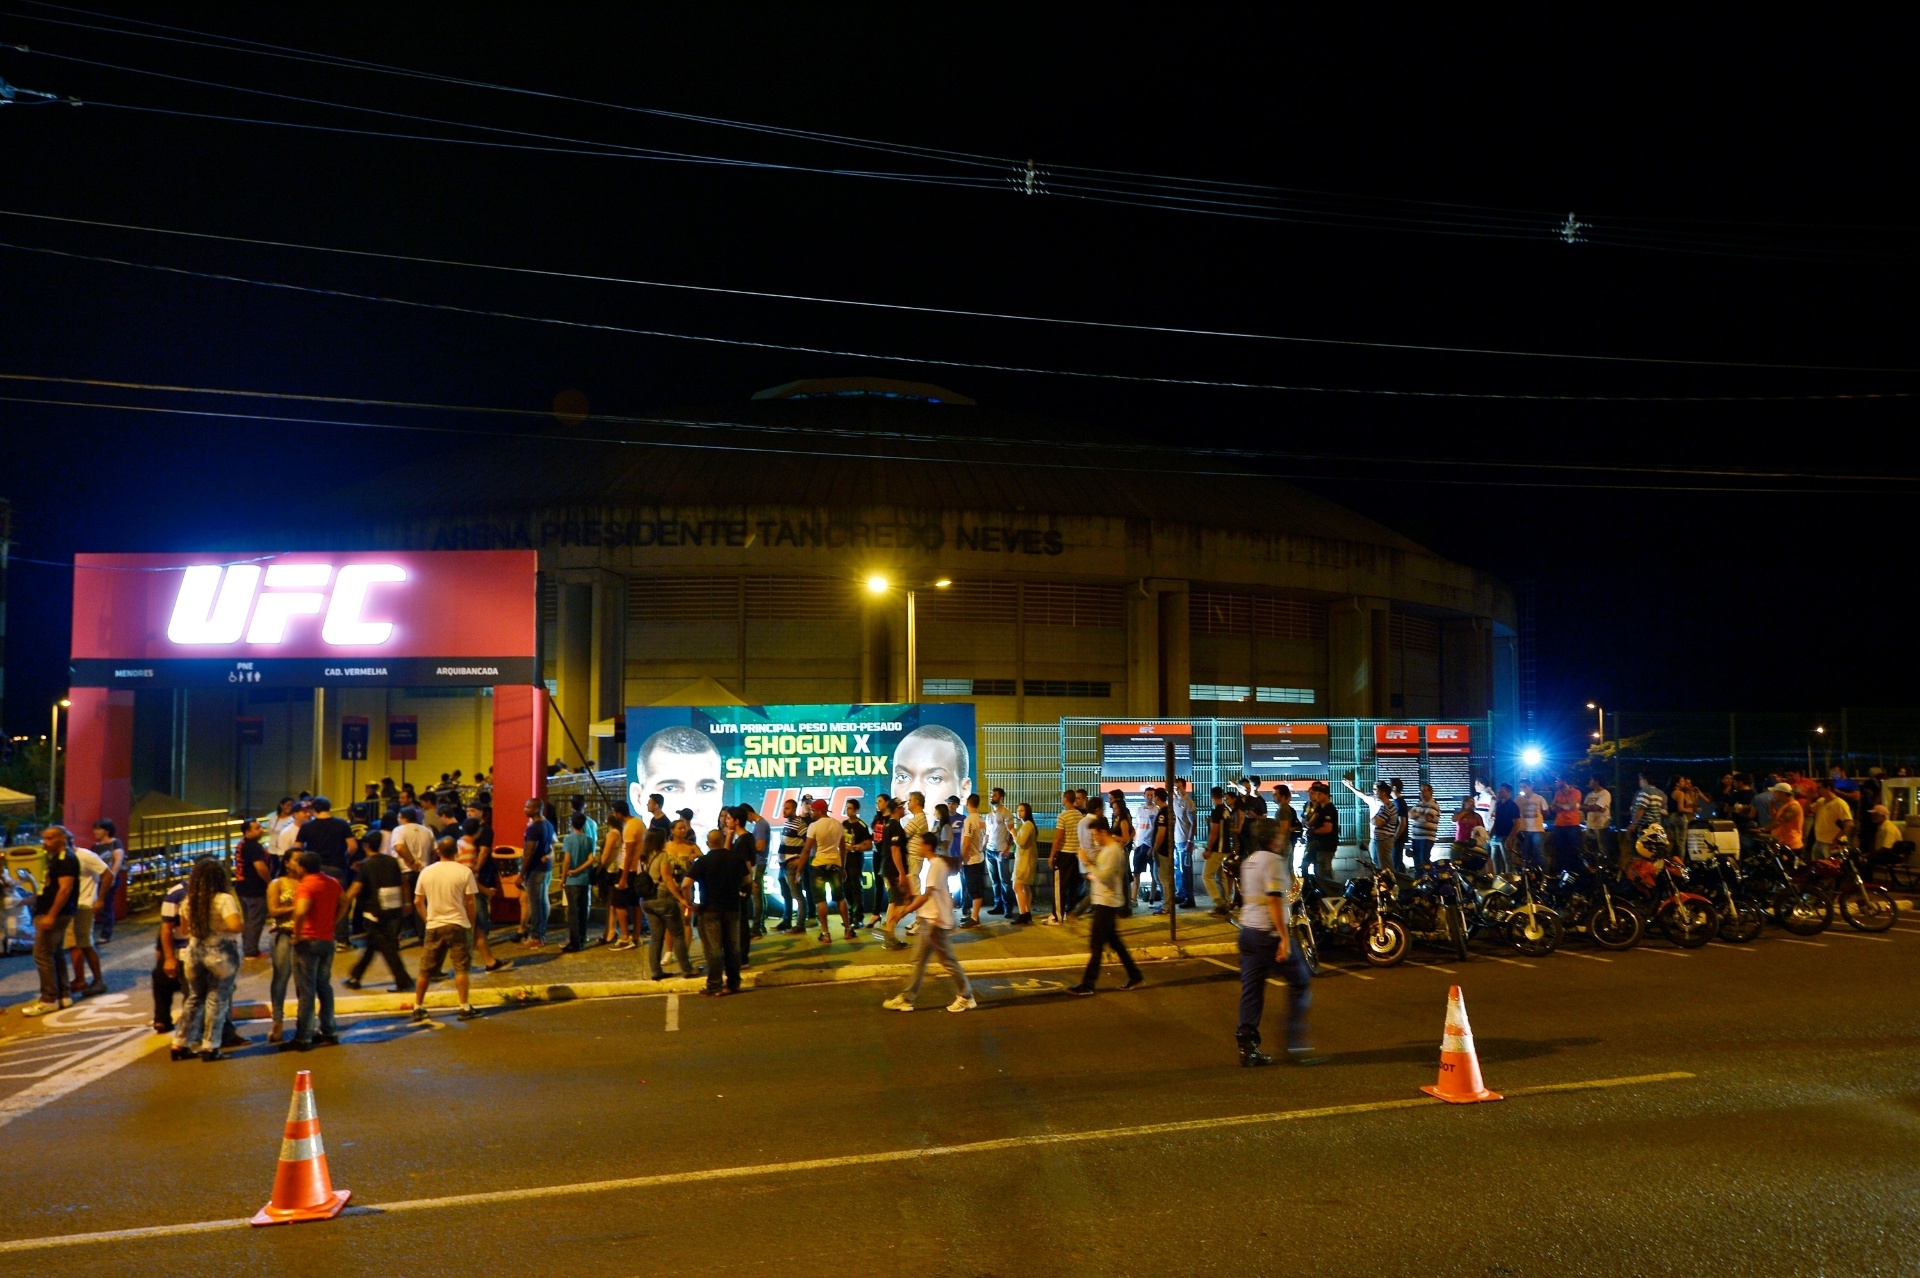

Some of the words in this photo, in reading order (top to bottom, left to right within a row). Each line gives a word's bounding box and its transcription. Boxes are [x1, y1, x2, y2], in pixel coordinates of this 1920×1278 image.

[542, 519, 745, 548] PRESIDENTE
[757, 520, 944, 550] TANCREDO
[956, 525, 1065, 555] NEVES
[166, 563, 407, 646] UFC
[236, 662, 254, 671] PNE
[324, 668, 343, 677] CAD.
[346, 668, 388, 677] VERMELHA
[436, 667, 499, 677] ARQUIBANCADA
[114, 669, 154, 678] MENORES
[710, 723, 738, 734] LUTA
[740, 723, 797, 734] PRINCIPAL
[798, 723, 828, 733] PESO
[829, 722, 902, 733] MEIO-PESADO
[744, 734, 848, 756] SHOGUN
[852, 733, 870, 754] X
[725, 757, 801, 779] SAINT
[807, 755, 890, 777] PREUX
